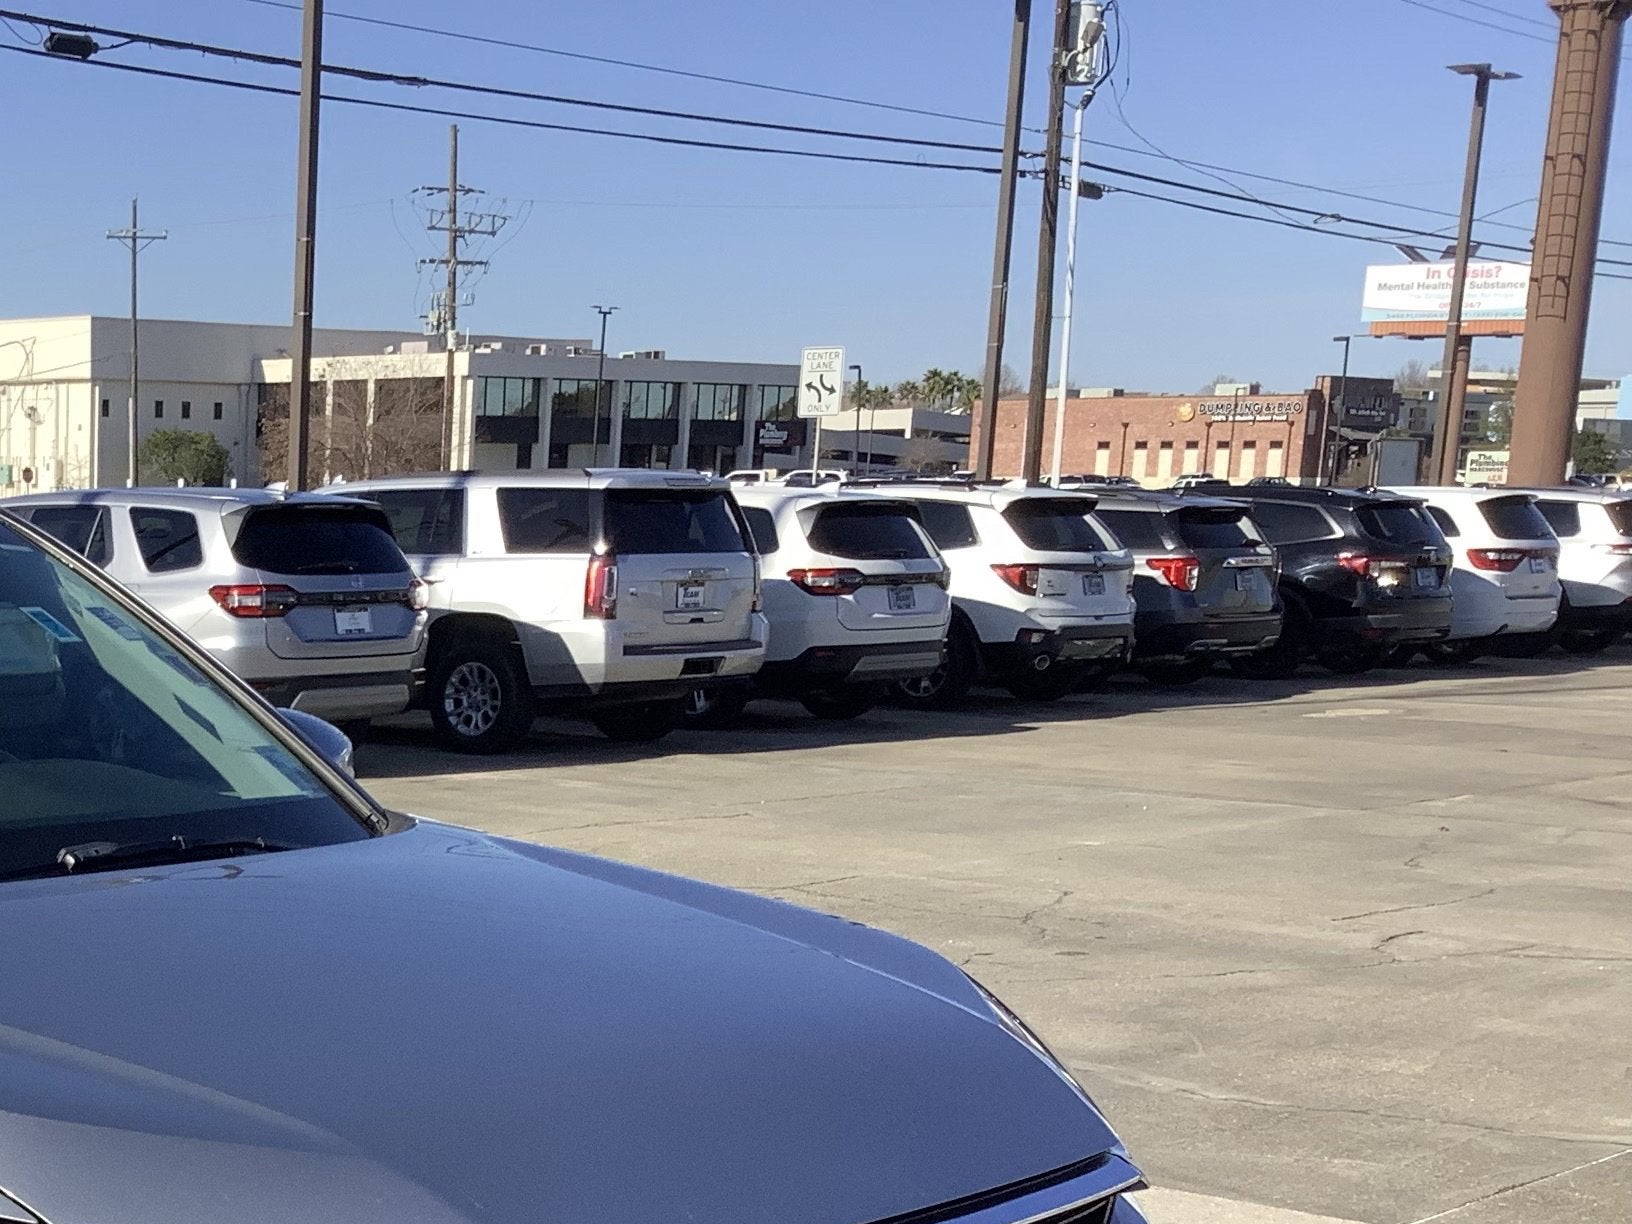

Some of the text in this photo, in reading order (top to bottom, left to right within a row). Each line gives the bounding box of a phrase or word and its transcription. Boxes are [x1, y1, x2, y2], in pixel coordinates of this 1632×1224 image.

[1425, 266, 1442, 280] In
[1377, 279, 1526, 292] Mental Health Substance
[806, 351, 840, 361] CENTER
[810, 361, 835, 370] LANE
[808, 404, 832, 413] ONLY
[1277, 402, 1303, 415] BAO
